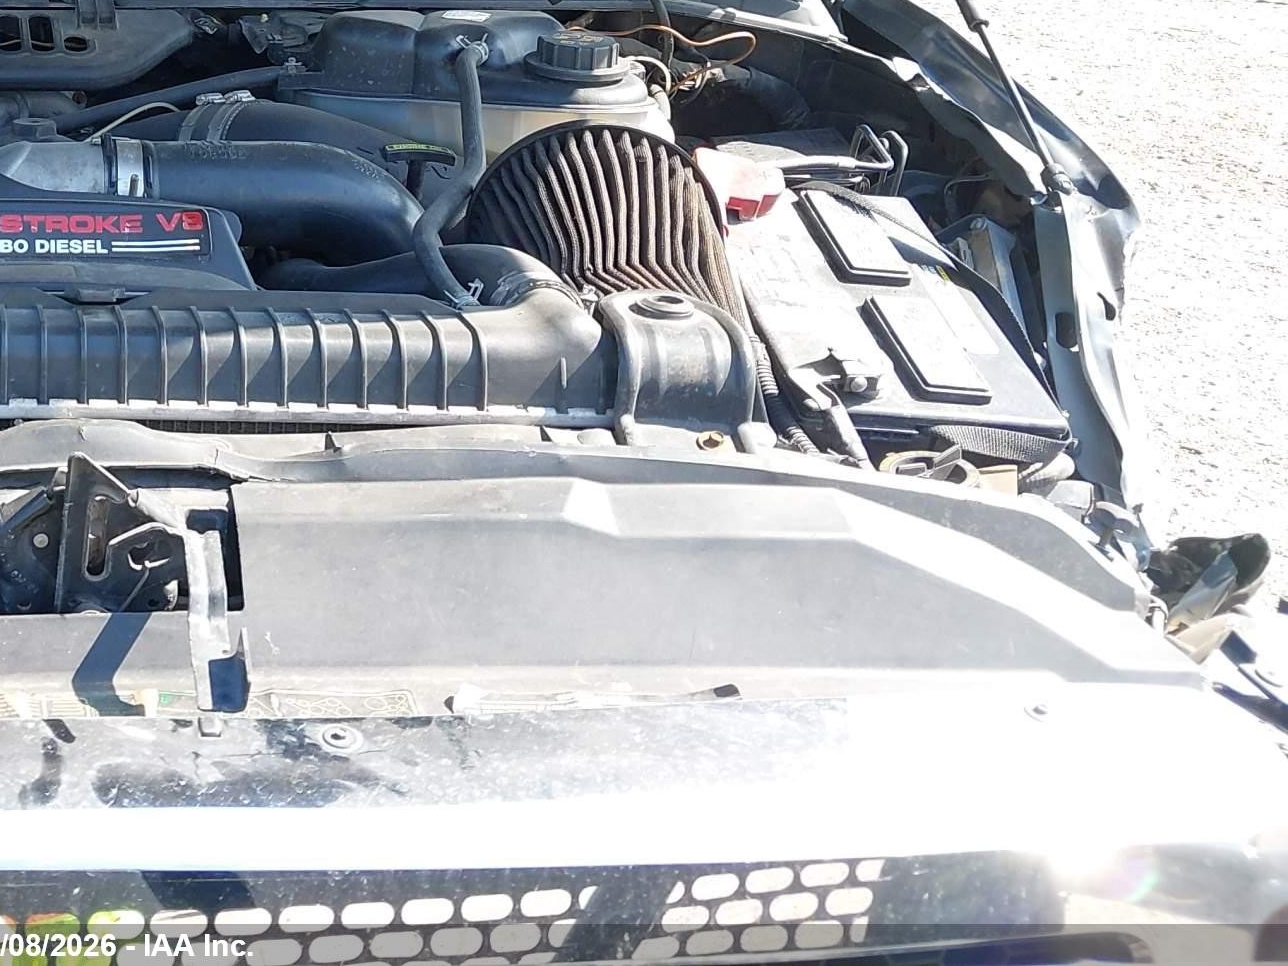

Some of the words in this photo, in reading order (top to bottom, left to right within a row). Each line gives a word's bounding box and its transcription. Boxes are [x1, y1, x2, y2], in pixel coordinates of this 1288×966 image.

[0, 213, 143, 234] STROKE
[155, 211, 203, 232] V8
[35, 238, 108, 254] DIESEL
